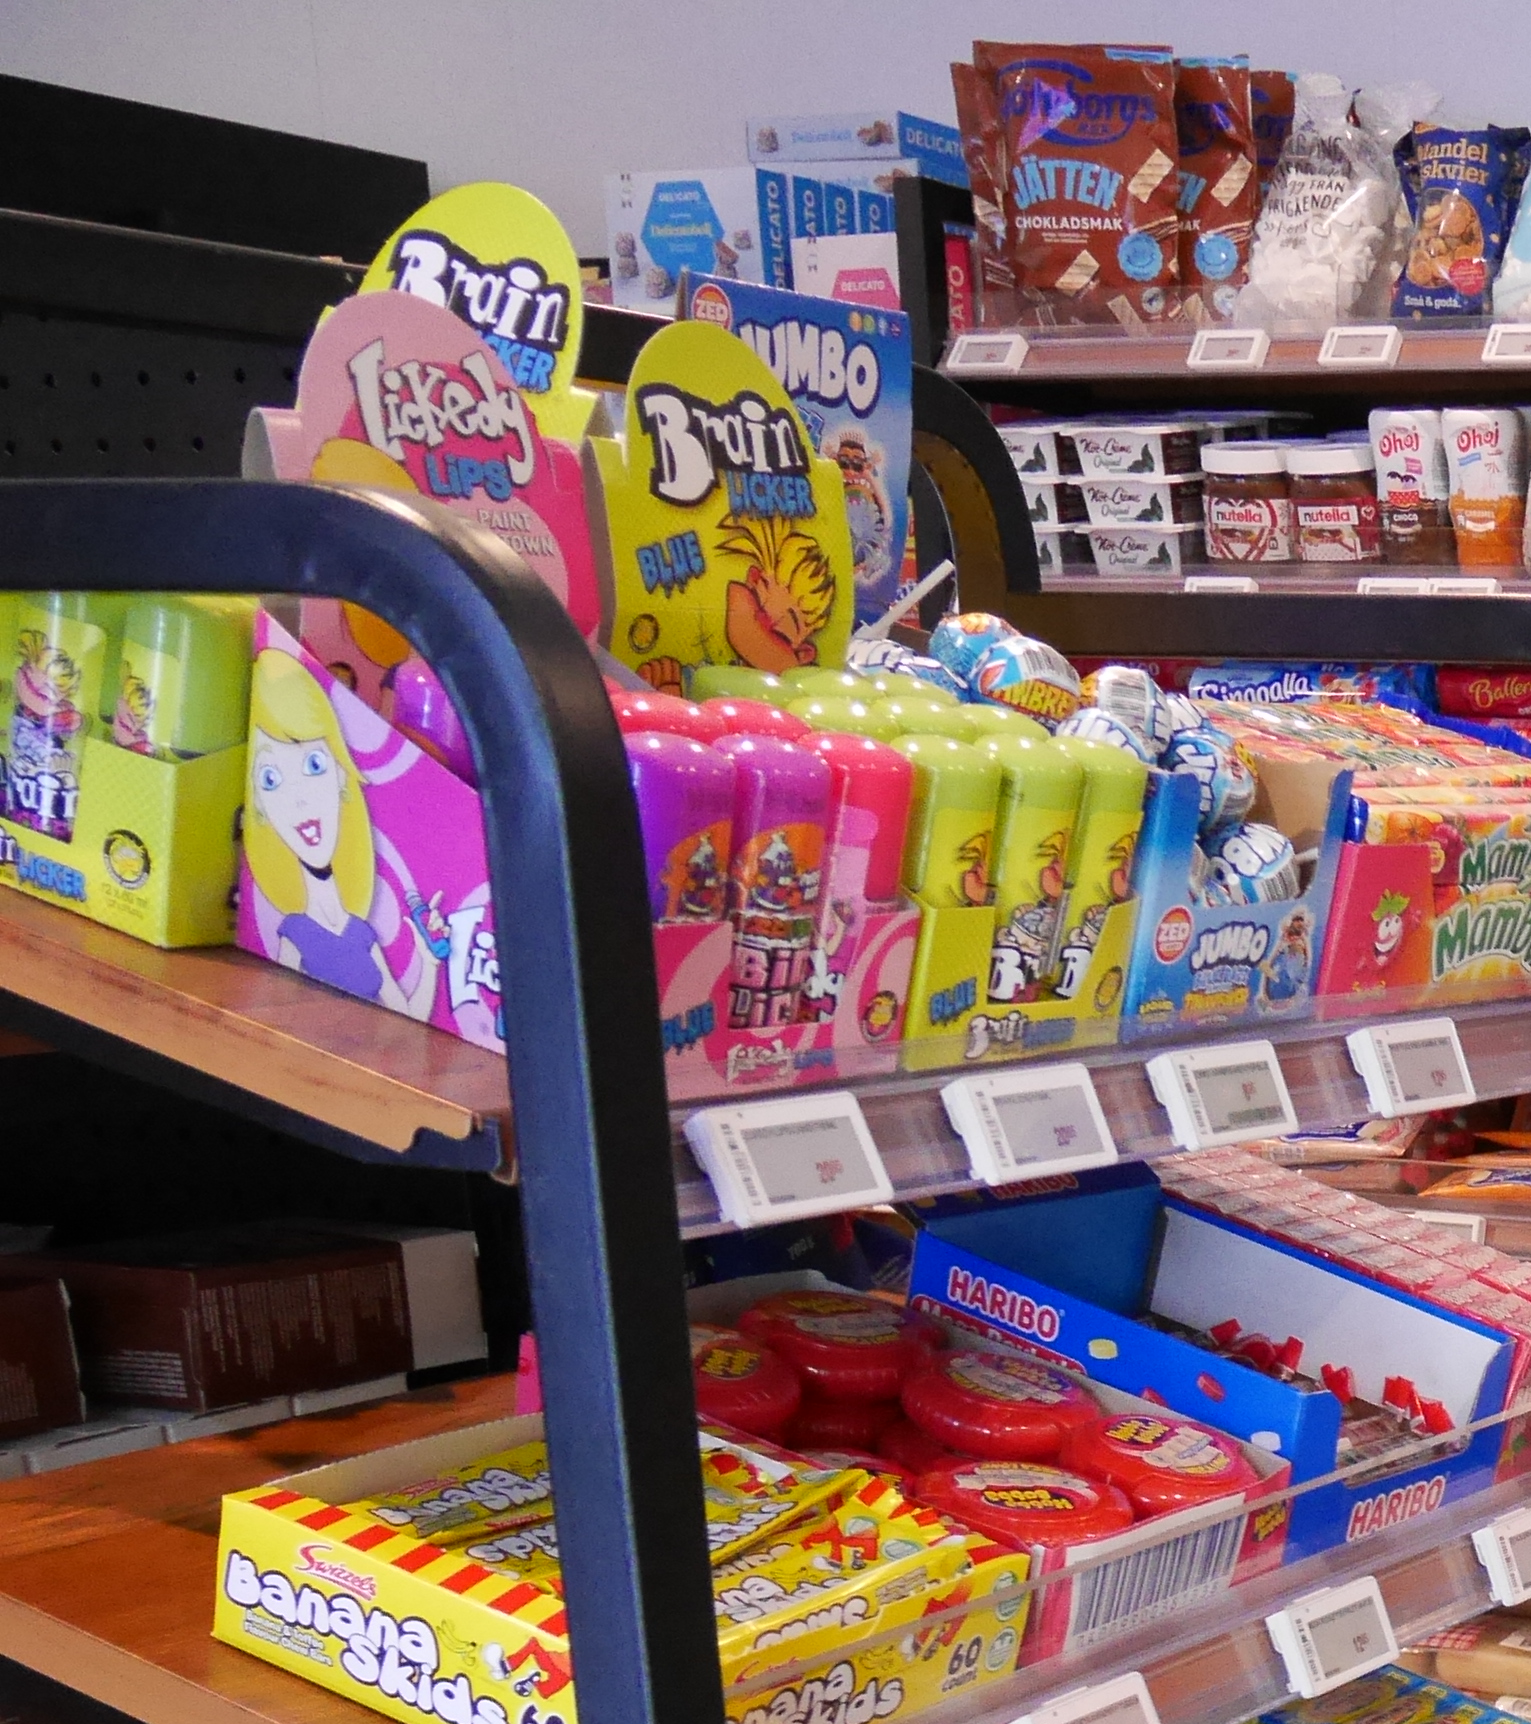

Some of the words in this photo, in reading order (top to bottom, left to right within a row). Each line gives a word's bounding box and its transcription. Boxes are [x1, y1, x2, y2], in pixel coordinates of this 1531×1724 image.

[1014, 155, 1123, 211] JÄTTEN
[1015, 216, 1123, 231] CHOKLADSMAK
[640, 387, 809, 504] Brain
[1456, 422, 1499, 453] Ohoj
[728, 469, 816, 516] LICKER
[1216, 509, 1262, 524] nutella
[1303, 510, 1351, 523] nutella
[1393, 513, 1418, 523] CHOCO
[636, 531, 705, 592] BLUE
[1156, 922, 1190, 950] ZED
[1190, 921, 1270, 976] JUMBO
[930, 978, 977, 1025] BLUE
[946, 1266, 1060, 1341] HARIBO
[1347, 1476, 1447, 1543] HARIBO
[225, 1550, 439, 1672] Banana
[948, 1636, 982, 1675] 60
[941, 1669, 979, 1695] count
